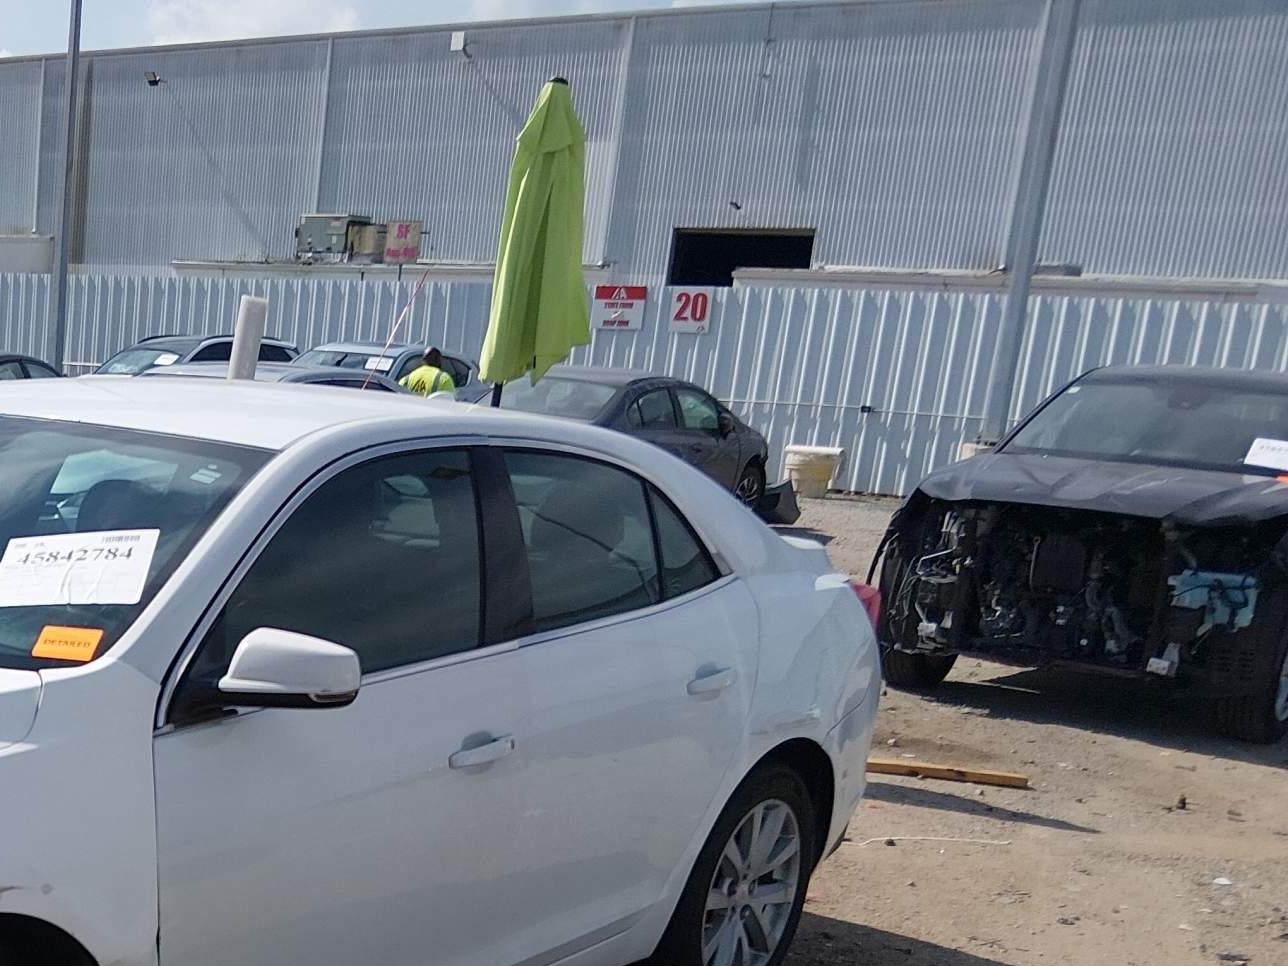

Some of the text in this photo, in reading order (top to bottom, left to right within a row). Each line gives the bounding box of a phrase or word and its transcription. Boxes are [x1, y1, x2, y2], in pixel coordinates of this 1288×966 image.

[672, 292, 708, 322] 20
[16, 546, 134, 565] 45842784
[43, 638, 91, 649] DETAILED
